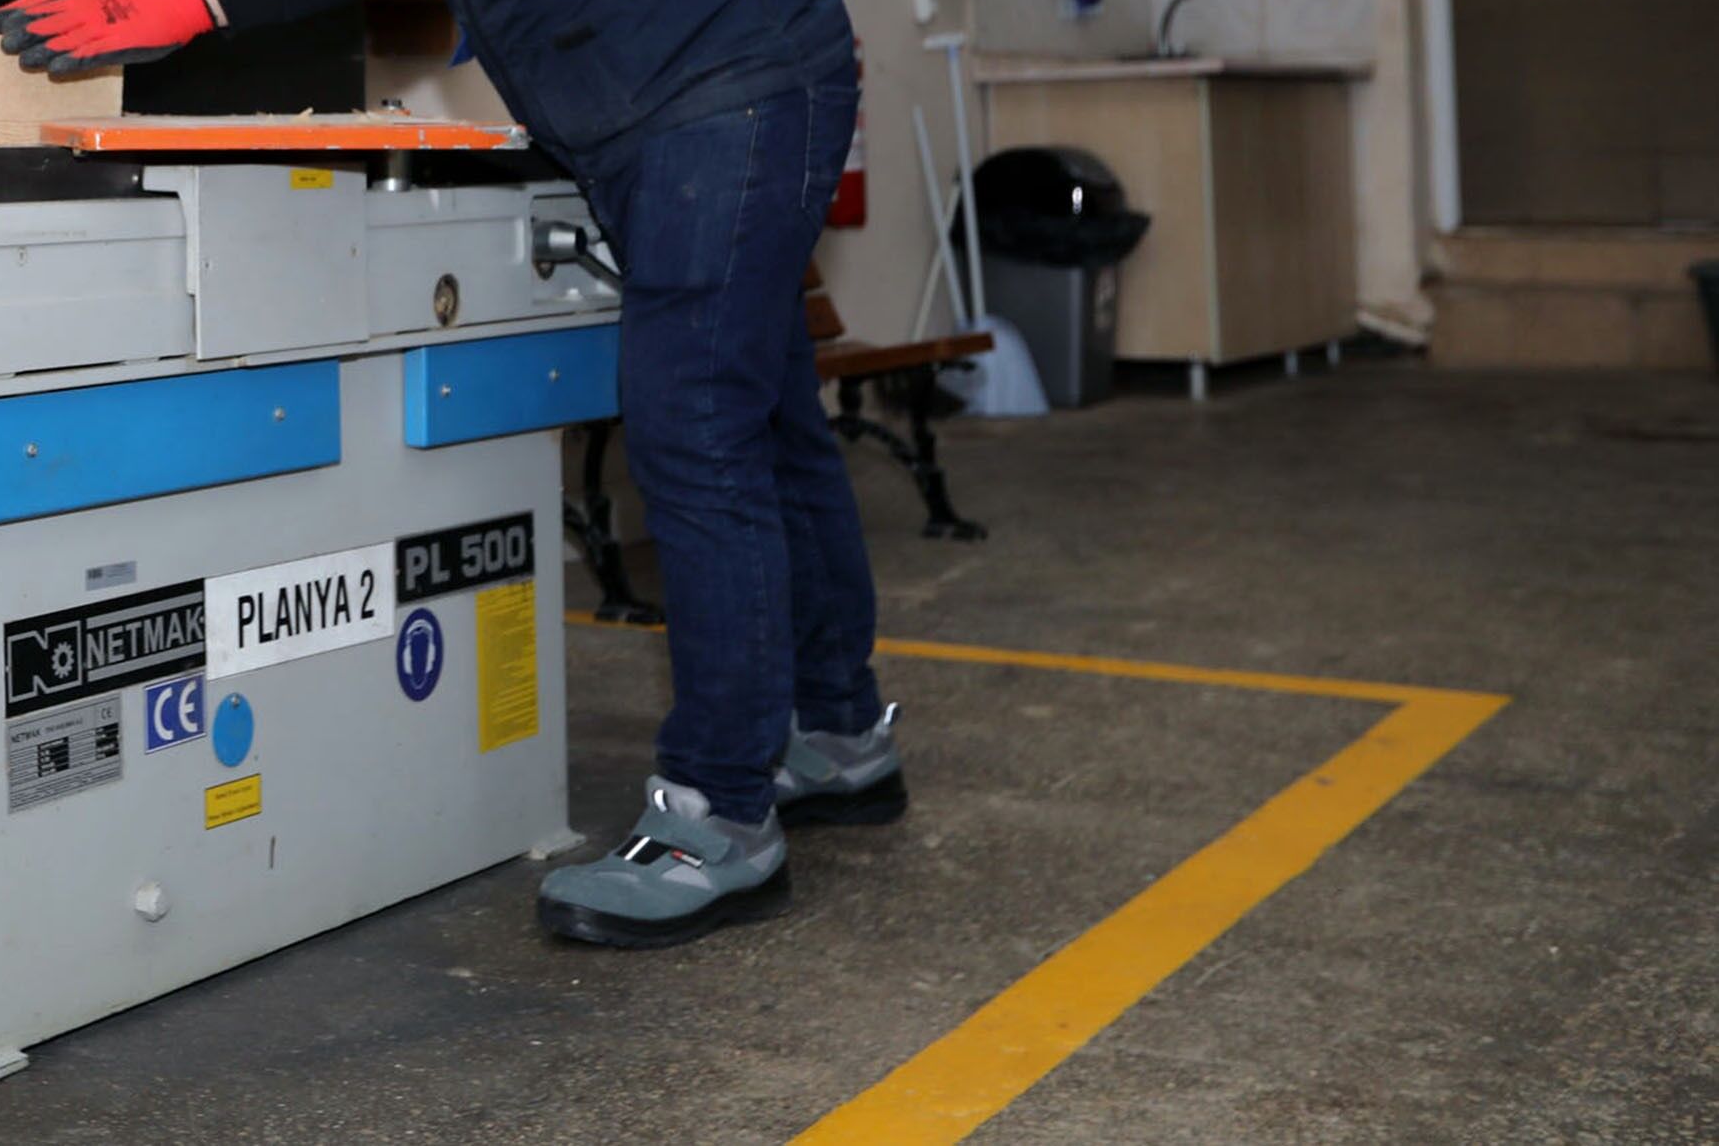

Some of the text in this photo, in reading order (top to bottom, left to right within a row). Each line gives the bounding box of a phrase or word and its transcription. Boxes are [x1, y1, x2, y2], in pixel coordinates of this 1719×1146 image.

[404, 525, 527, 591] PL 500
[86, 604, 205, 670] NETMAK
[238, 569, 376, 649] PLANYA 2
[153, 680, 200, 741] CE
